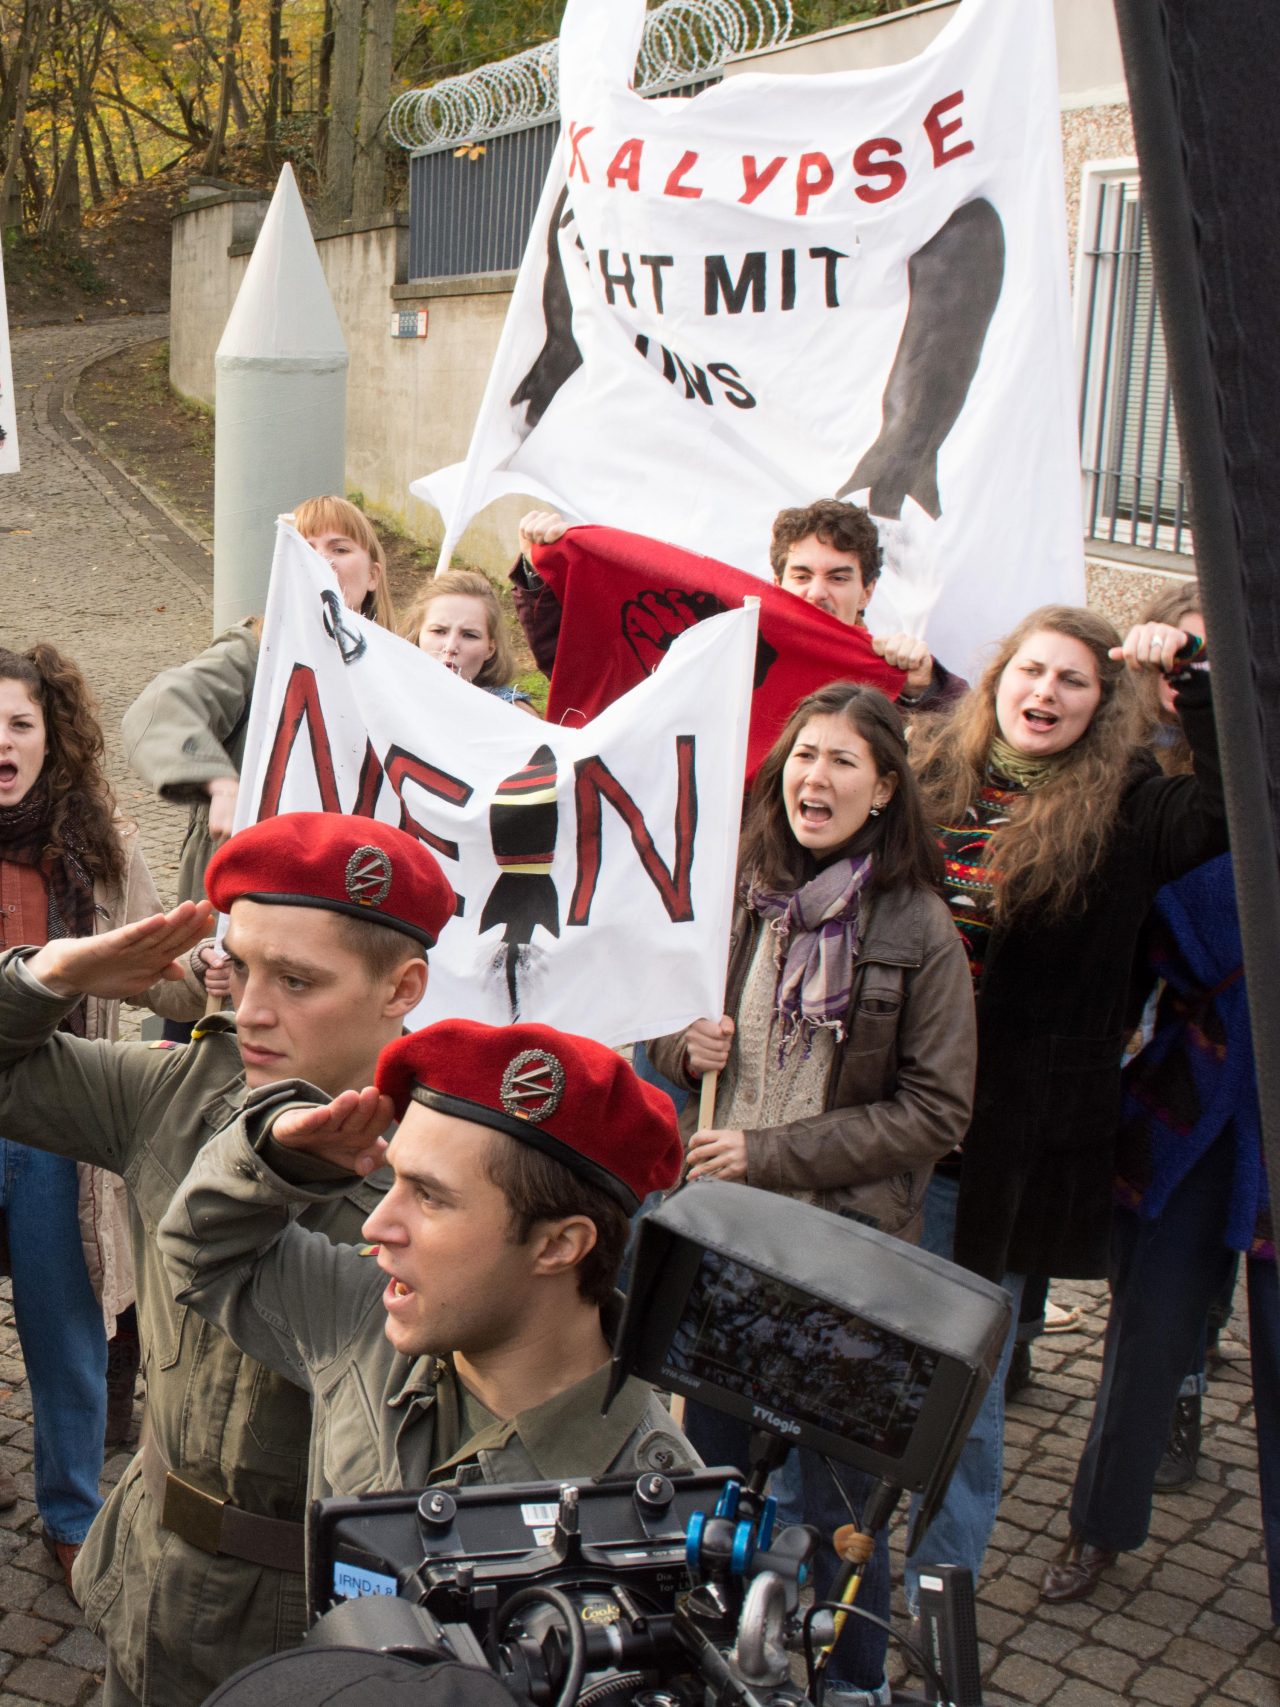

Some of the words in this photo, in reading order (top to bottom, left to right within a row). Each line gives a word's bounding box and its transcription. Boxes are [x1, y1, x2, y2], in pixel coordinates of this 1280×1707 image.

[704, 246, 850, 317] MIT
[753, 1405, 801, 1436] TVlogic
[339, 1573, 371, 1593] IRND
